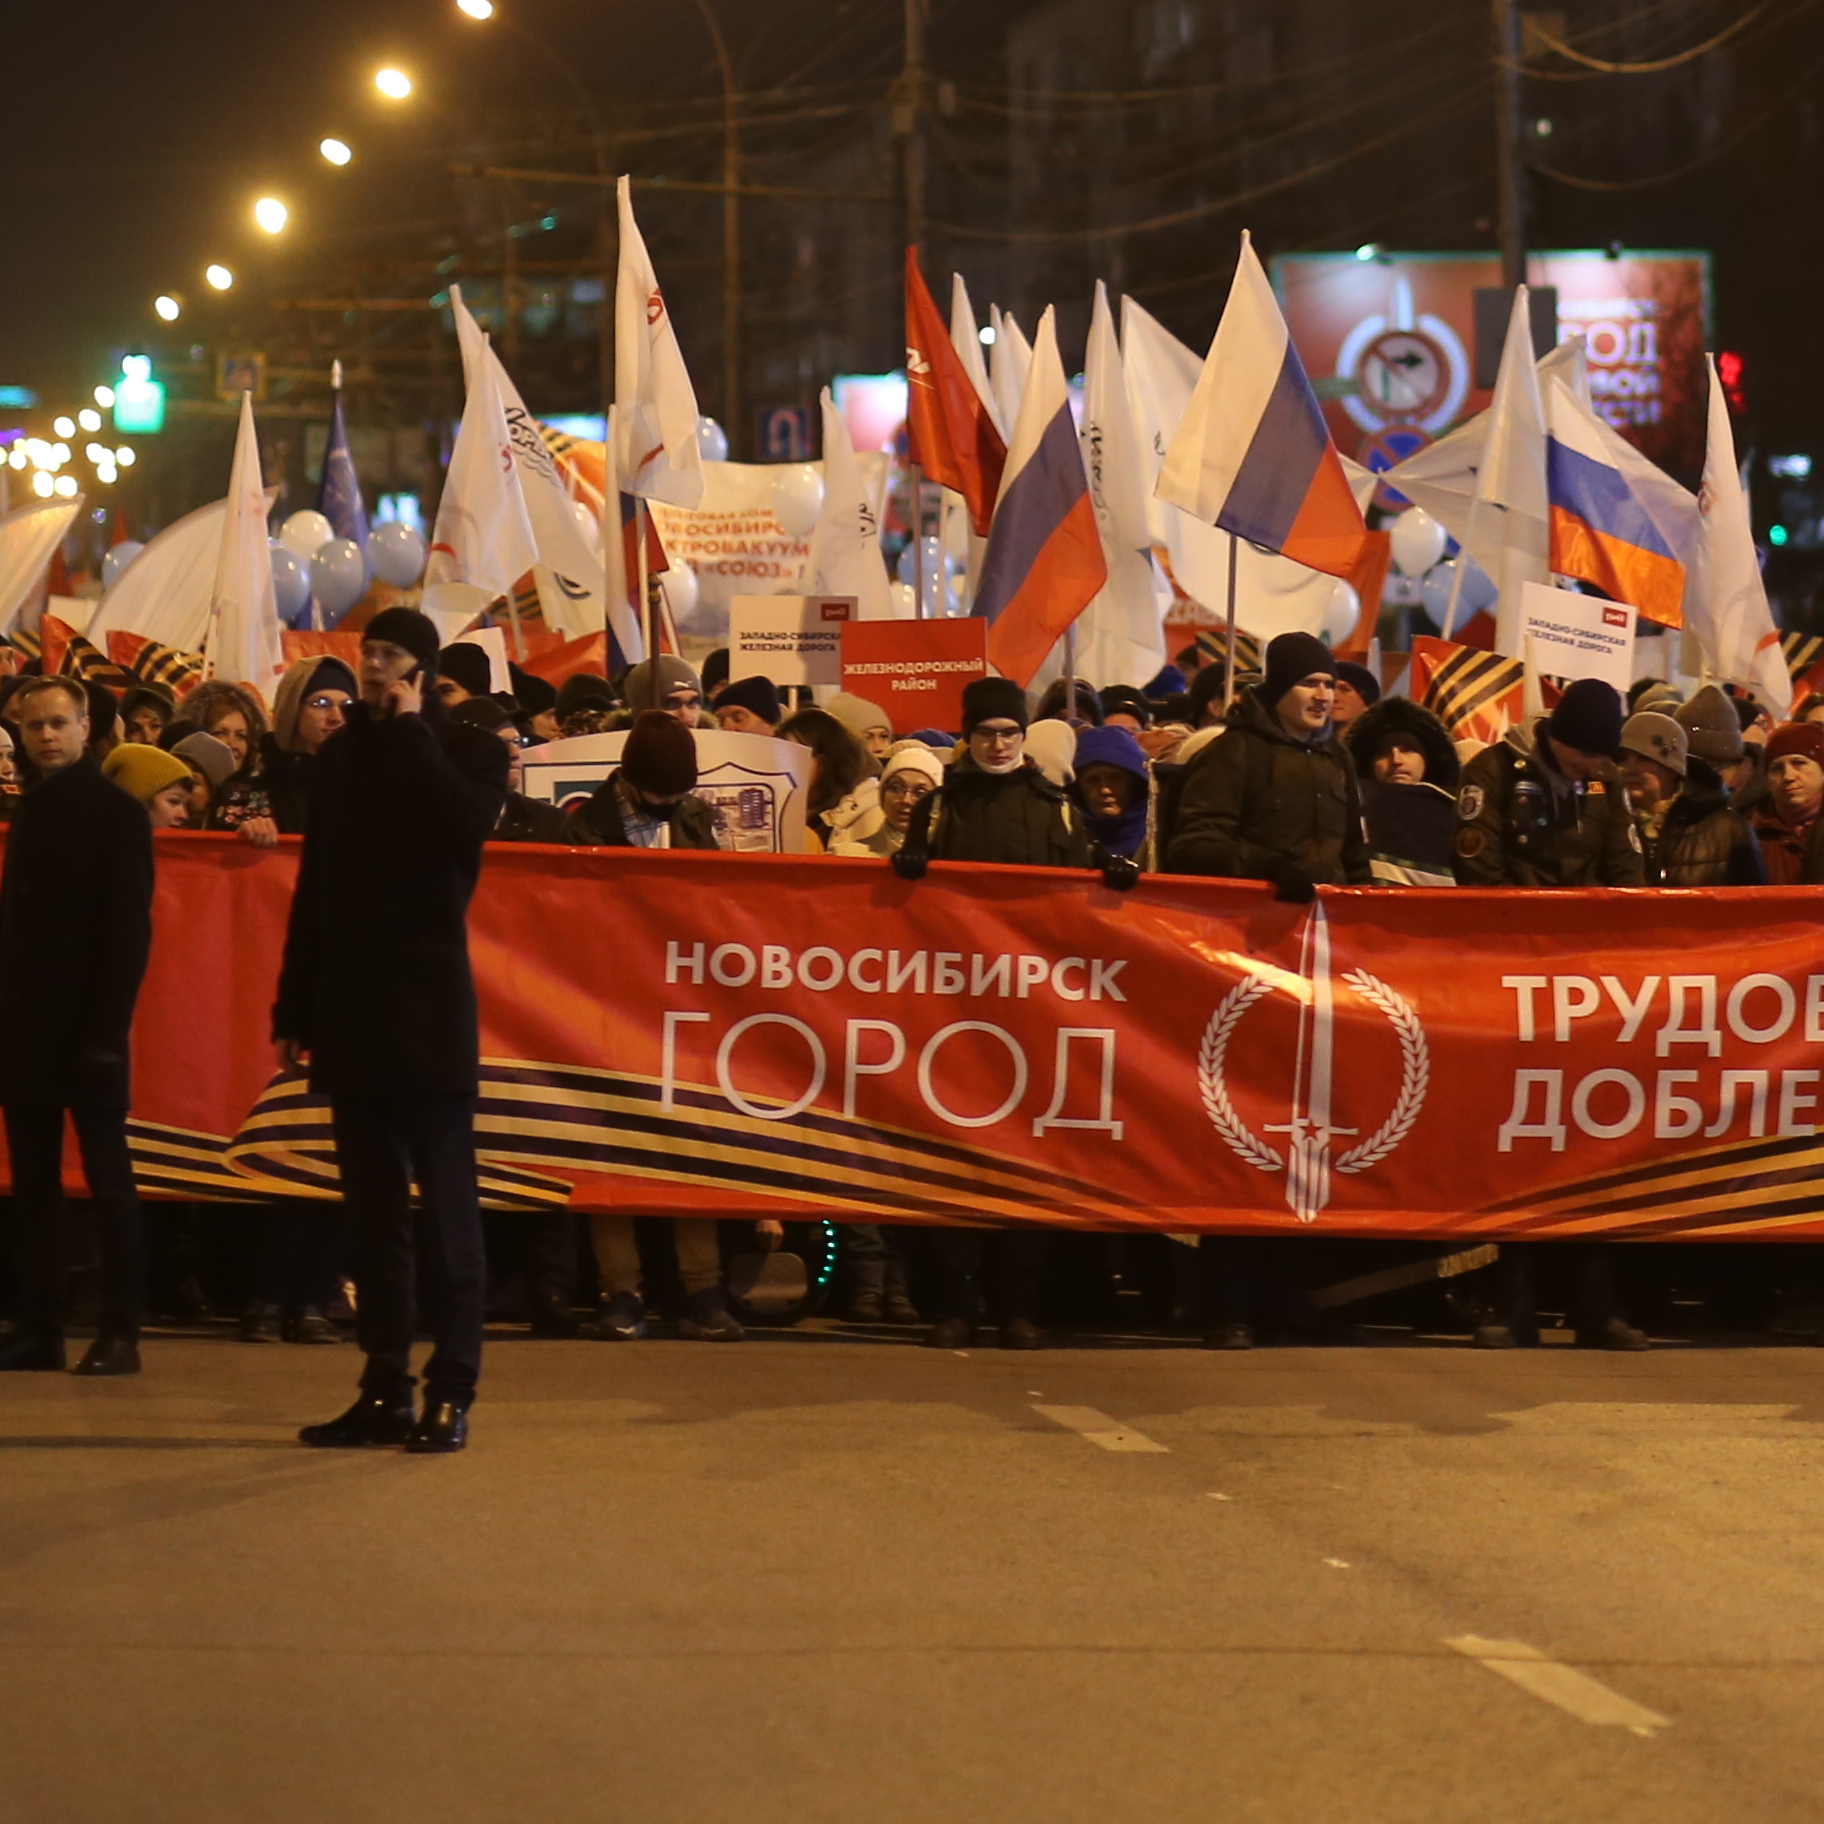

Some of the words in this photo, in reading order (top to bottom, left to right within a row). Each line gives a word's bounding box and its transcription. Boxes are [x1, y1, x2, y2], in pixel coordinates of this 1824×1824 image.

[739, 642, 793, 652] ЖЕЛЕЗНАЯ
[796, 642, 836, 653] ДОРОГА
[1577, 640, 1613, 655] ДОРОГА
[843, 658, 984, 676] ЖЕЛЕЗНОДОРОЖНЫЙ
[891, 677, 937, 692] РАЙОН
[665, 940, 1128, 1002] НОВОСИБИРСК
[660, 1010, 1125, 1142] ГОРОД
